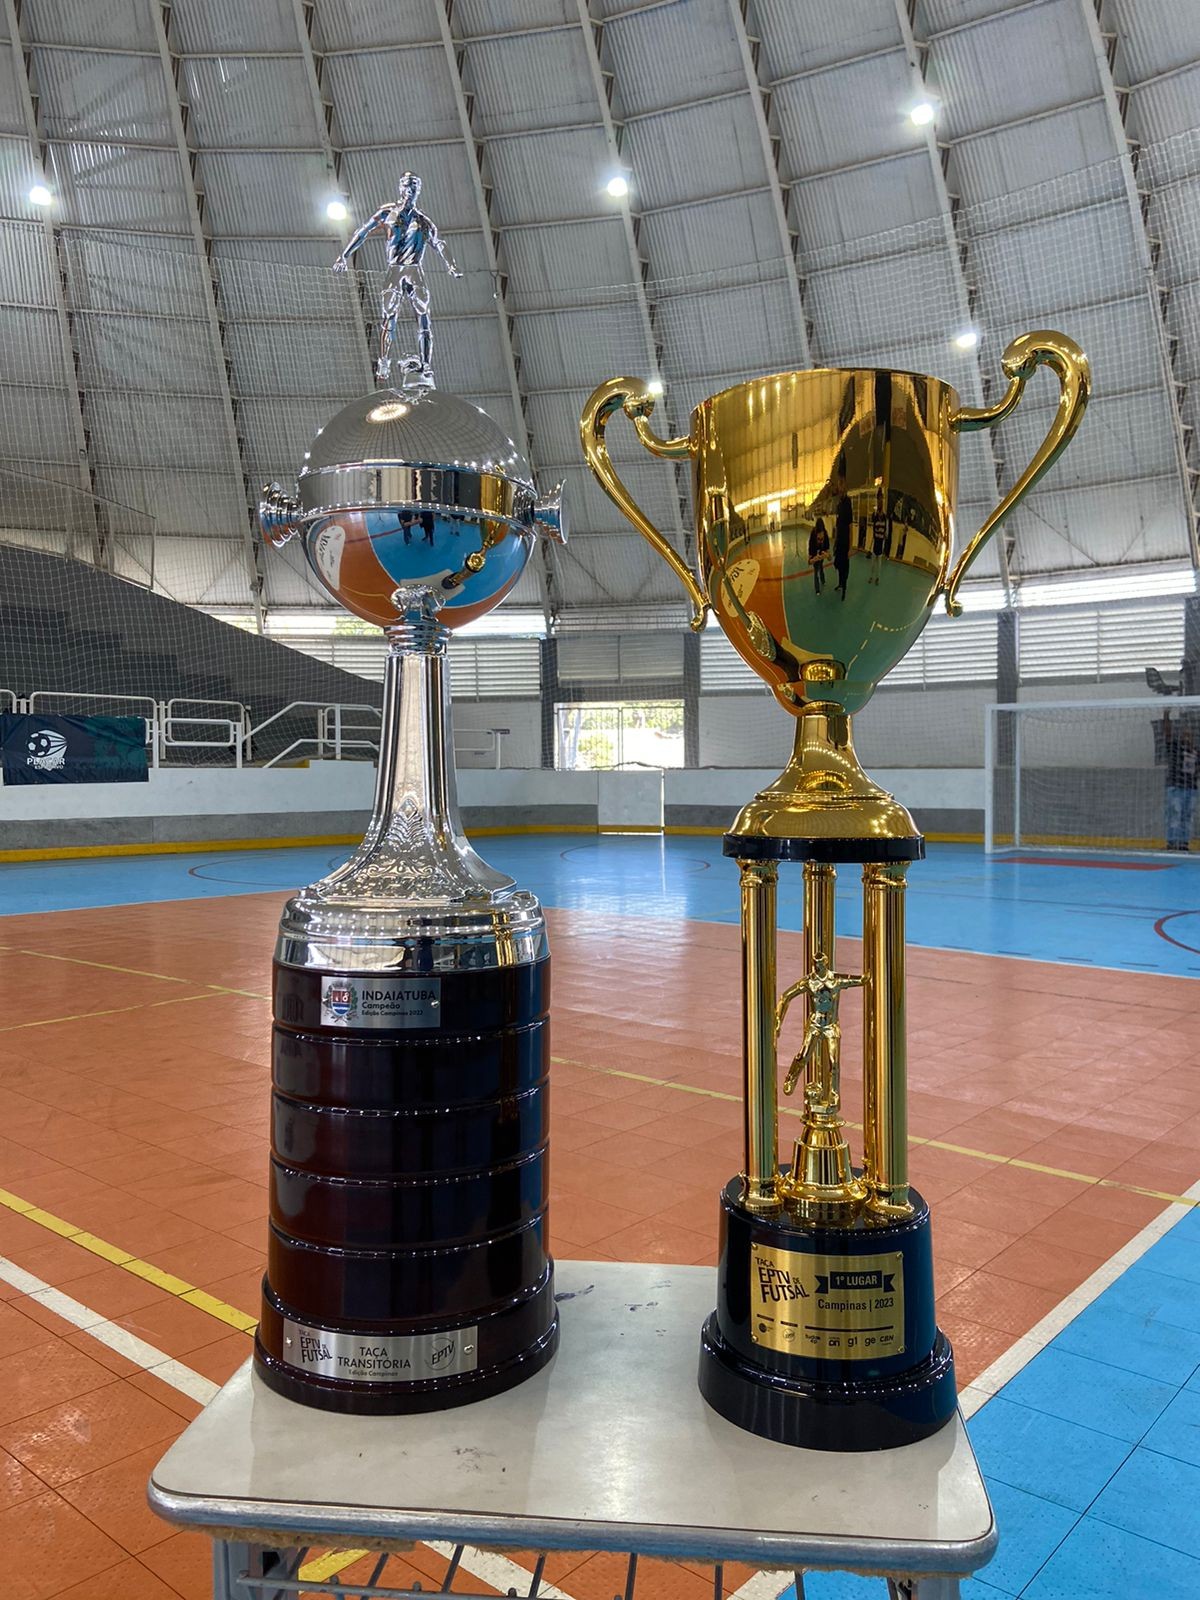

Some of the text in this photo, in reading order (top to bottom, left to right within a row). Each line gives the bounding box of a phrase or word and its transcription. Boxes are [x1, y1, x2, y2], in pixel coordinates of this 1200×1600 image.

[362, 990, 436, 1001] INDAIATUBA
[361, 1001, 401, 1010] Campeão
[756, 1257, 774, 1268] TAÇA
[758, 1267, 790, 1284] EPTV
[846, 1275, 878, 1285] LUGAR
[761, 1284, 810, 1303] FUTSAL
[817, 1299, 867, 1312] Campinas
[874, 1297, 894, 1309] 2023
[300, 1336, 321, 1349] EPTV
[847, 1336, 858, 1348] g1
[864, 1337, 876, 1347] ge
[301, 1348, 333, 1364] FUTSAL
[359, 1346, 388, 1358] TAÇA
[431, 1343, 455, 1365] EPTV
[337, 1356, 411, 1369] TRANSITÓRIA
